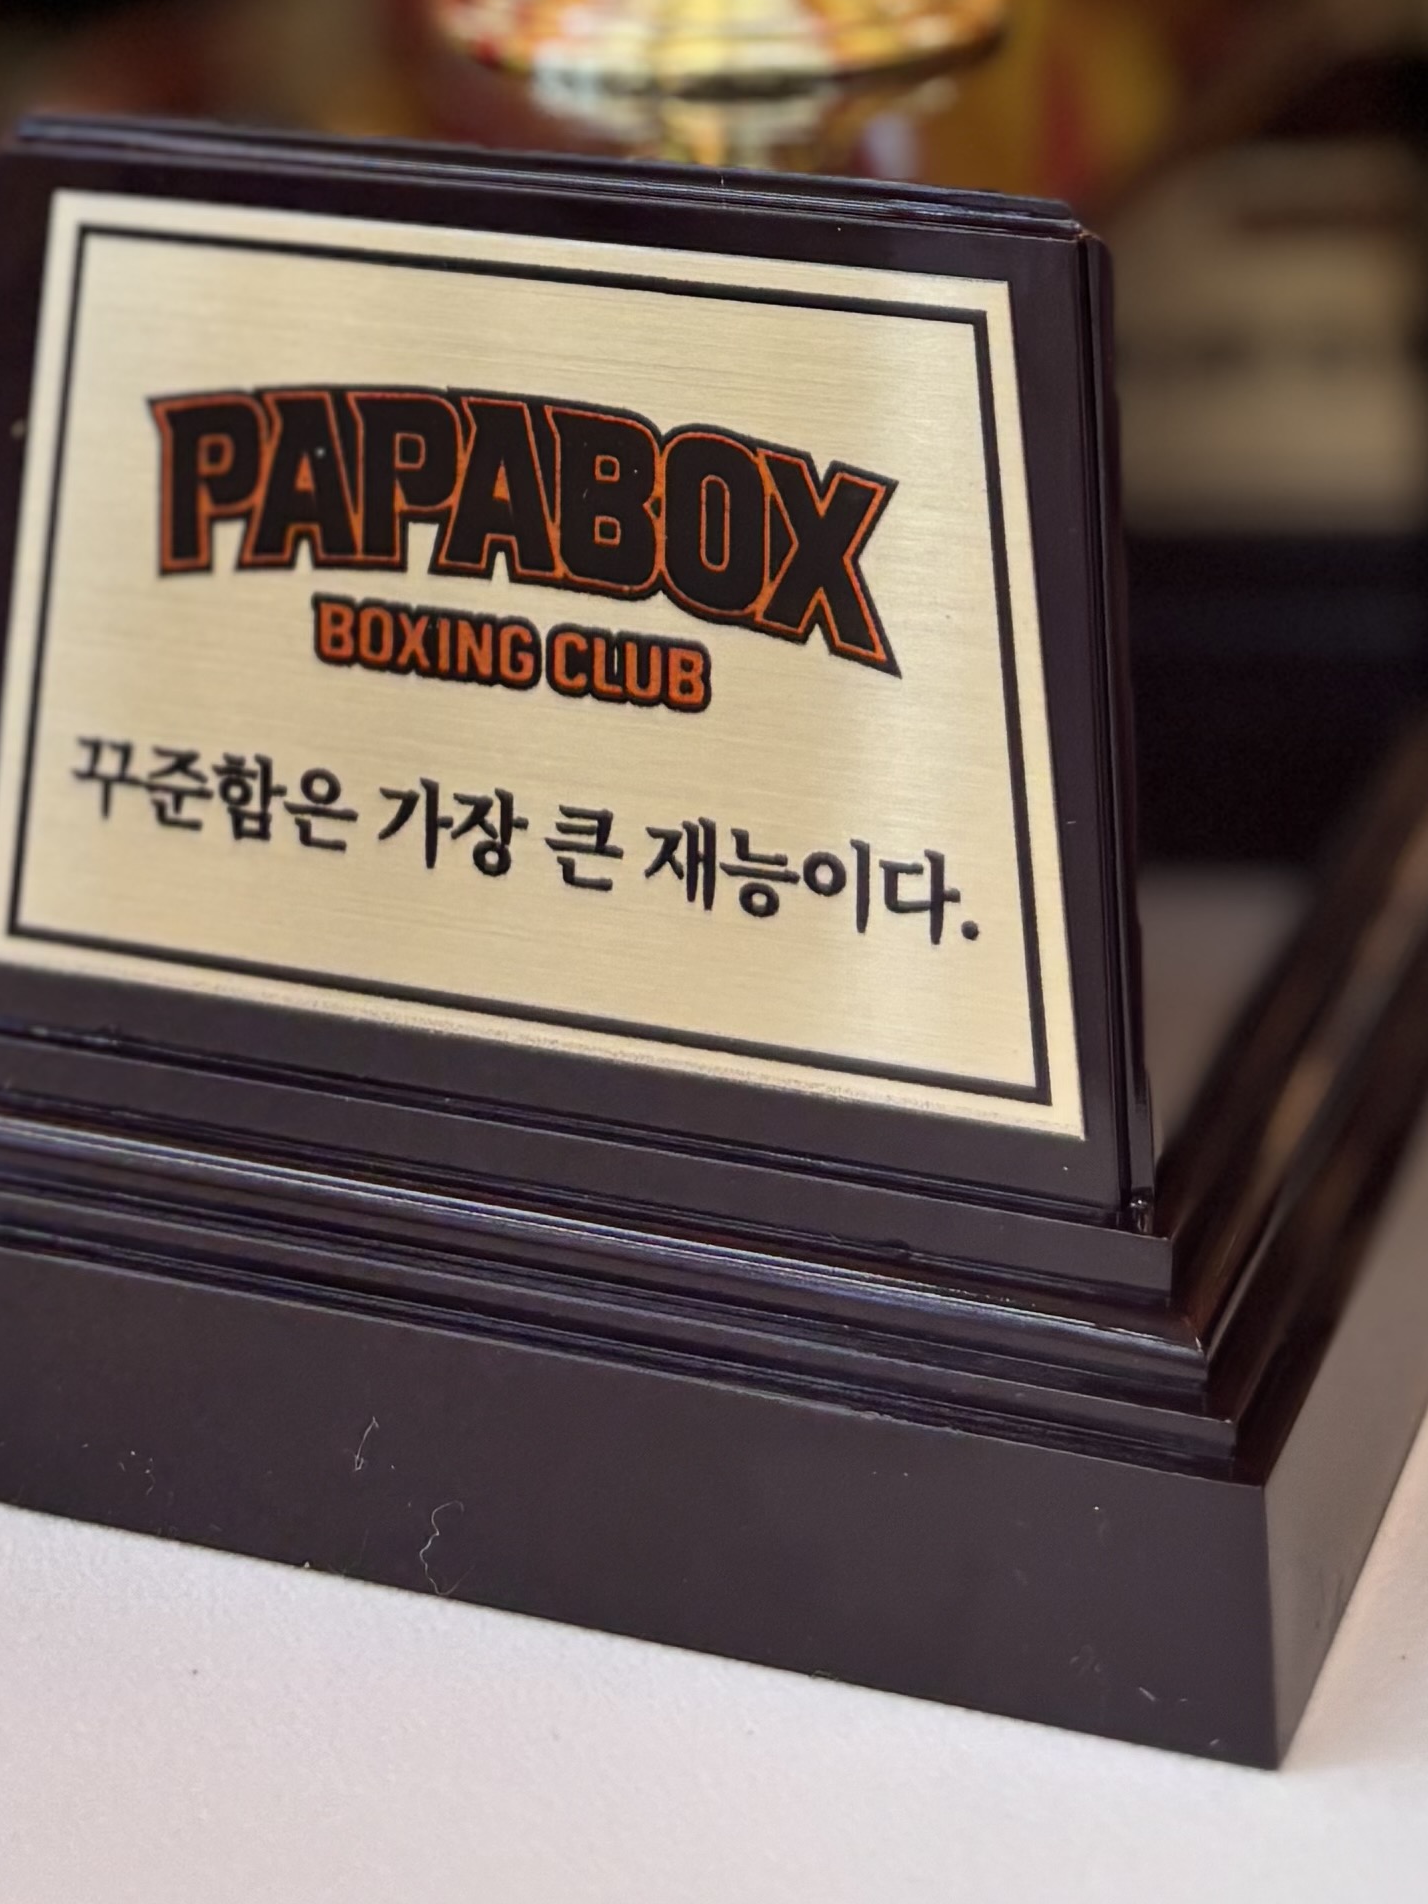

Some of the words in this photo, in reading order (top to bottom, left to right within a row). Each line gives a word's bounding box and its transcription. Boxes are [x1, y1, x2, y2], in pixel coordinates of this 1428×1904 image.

[147, 384, 902, 678] PAPABOX
[311, 592, 539, 690] BOXING
[544, 626, 714, 713] CLUB
[72, 737, 359, 851] 꾸준함은
[377, 778, 528, 878] 가장
[544, 803, 625, 891] 큰
[643, 817, 982, 944] 재능이다.
